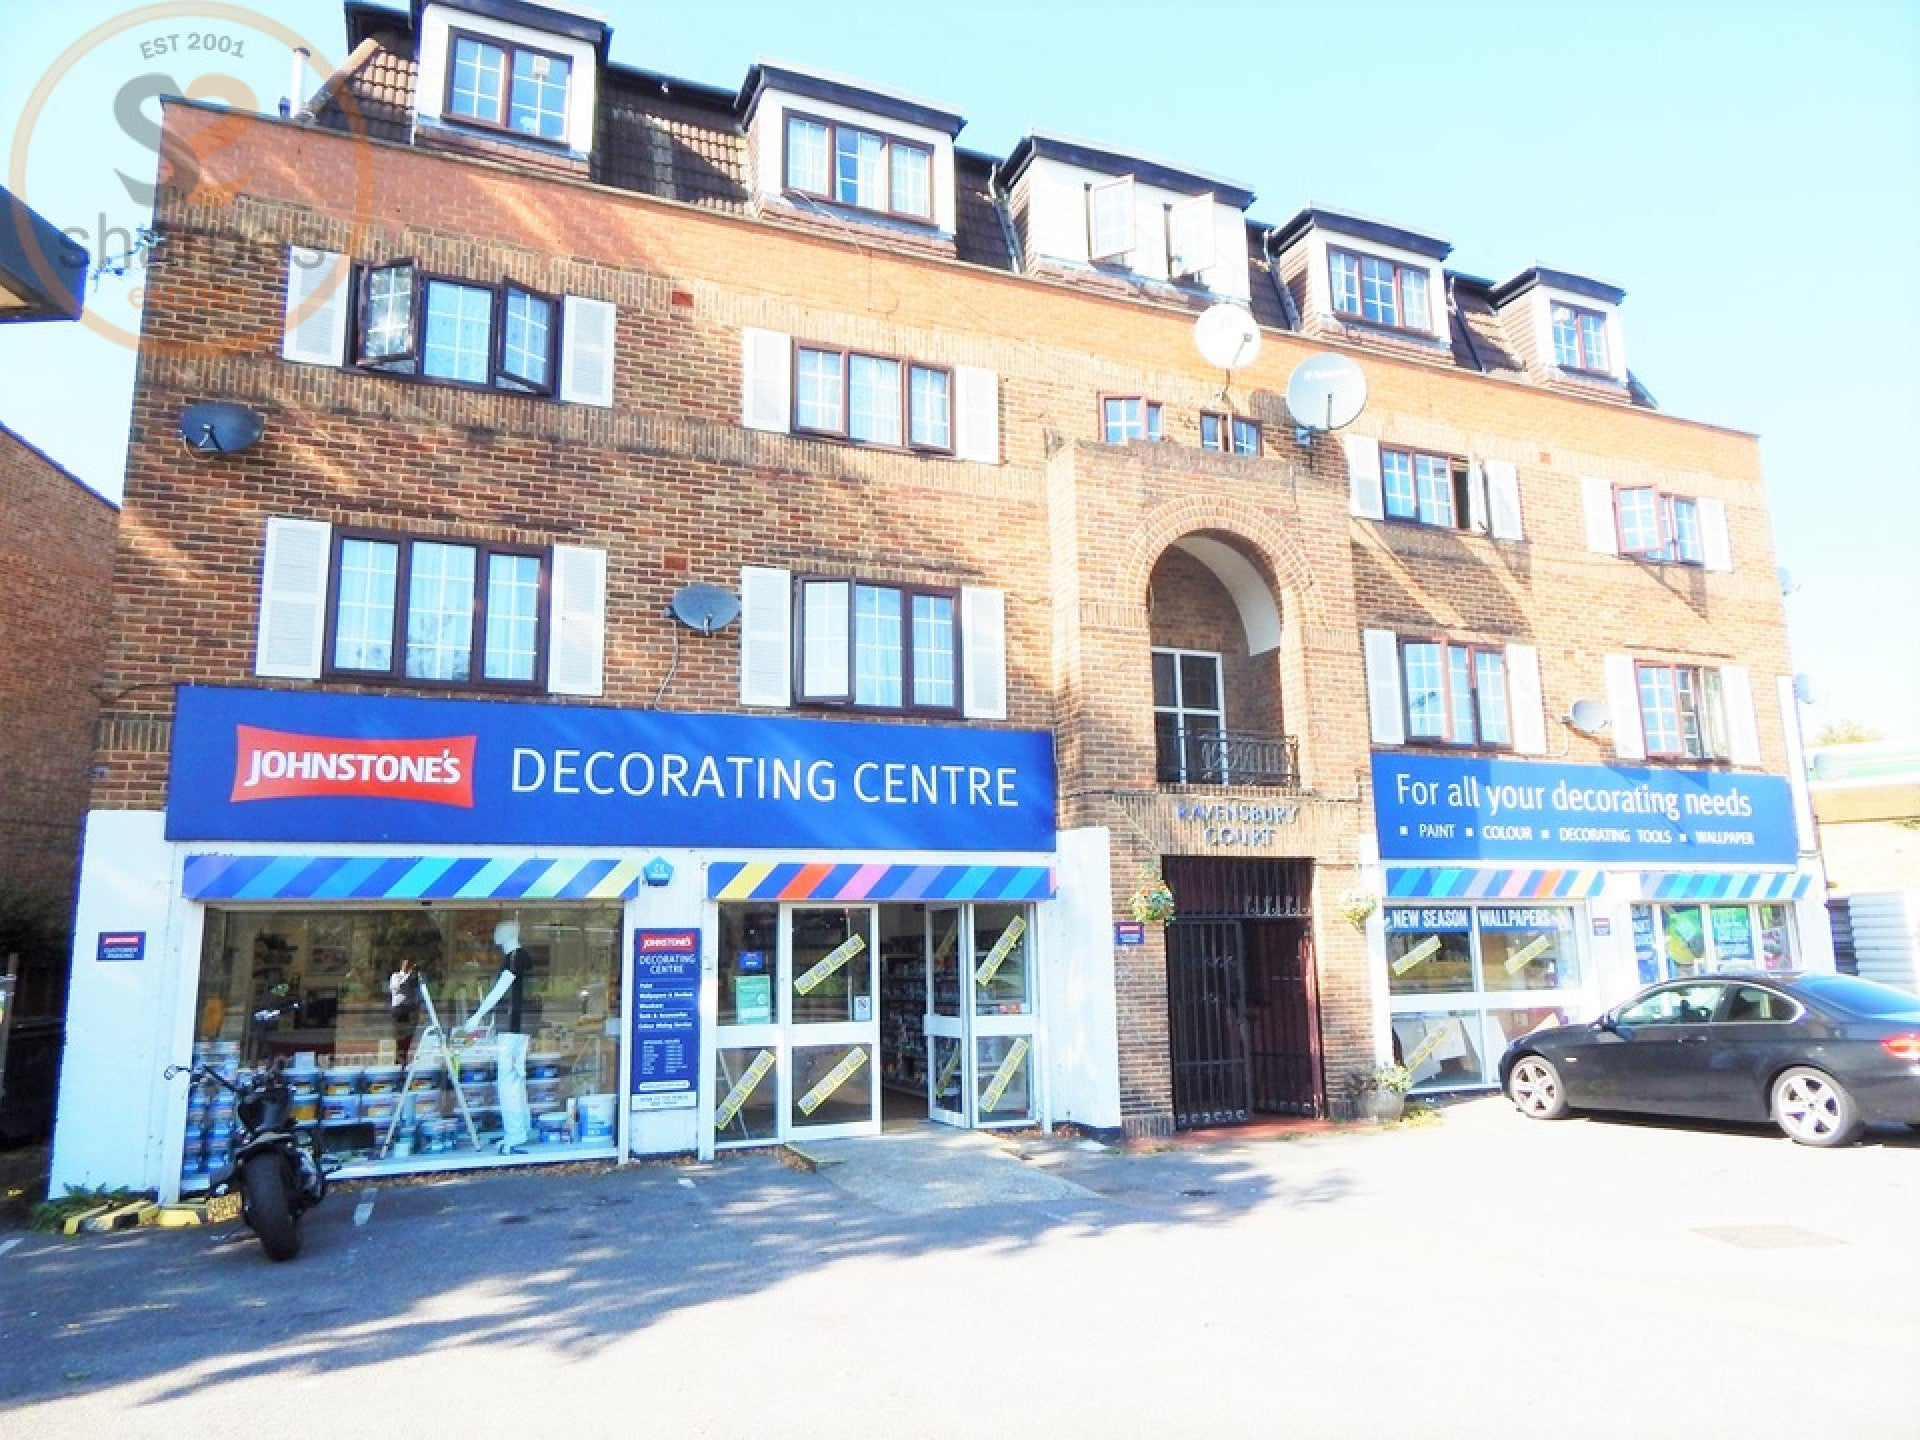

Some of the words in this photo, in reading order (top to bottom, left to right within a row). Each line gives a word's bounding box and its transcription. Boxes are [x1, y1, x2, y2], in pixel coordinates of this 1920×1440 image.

[244, 749, 461, 787] JOHNSTONE'S
[512, 747, 836, 802] DECORATING
[854, 762, 1019, 807] CENTRE
[1396, 774, 1439, 805] For
[1448, 776, 1480, 807] all
[1485, 785, 1545, 816] your
[1552, 779, 1680, 821] decorating
[1685, 788, 1752, 817] needs
[1204, 828, 1276, 847] COURT
[1419, 823, 1456, 839] PAINT
[1482, 825, 1533, 841] COLOUR
[1559, 827, 1631, 843] DECORATING
[1636, 829, 1673, 843] TOOLS
[1695, 831, 1755, 845] WALLPAPER
[1392, 909, 1418, 928] NEW
[1422, 909, 1469, 928] SEASON
[639, 953, 696, 965] DECORATING
[650, 964, 684, 975] CENTRE
